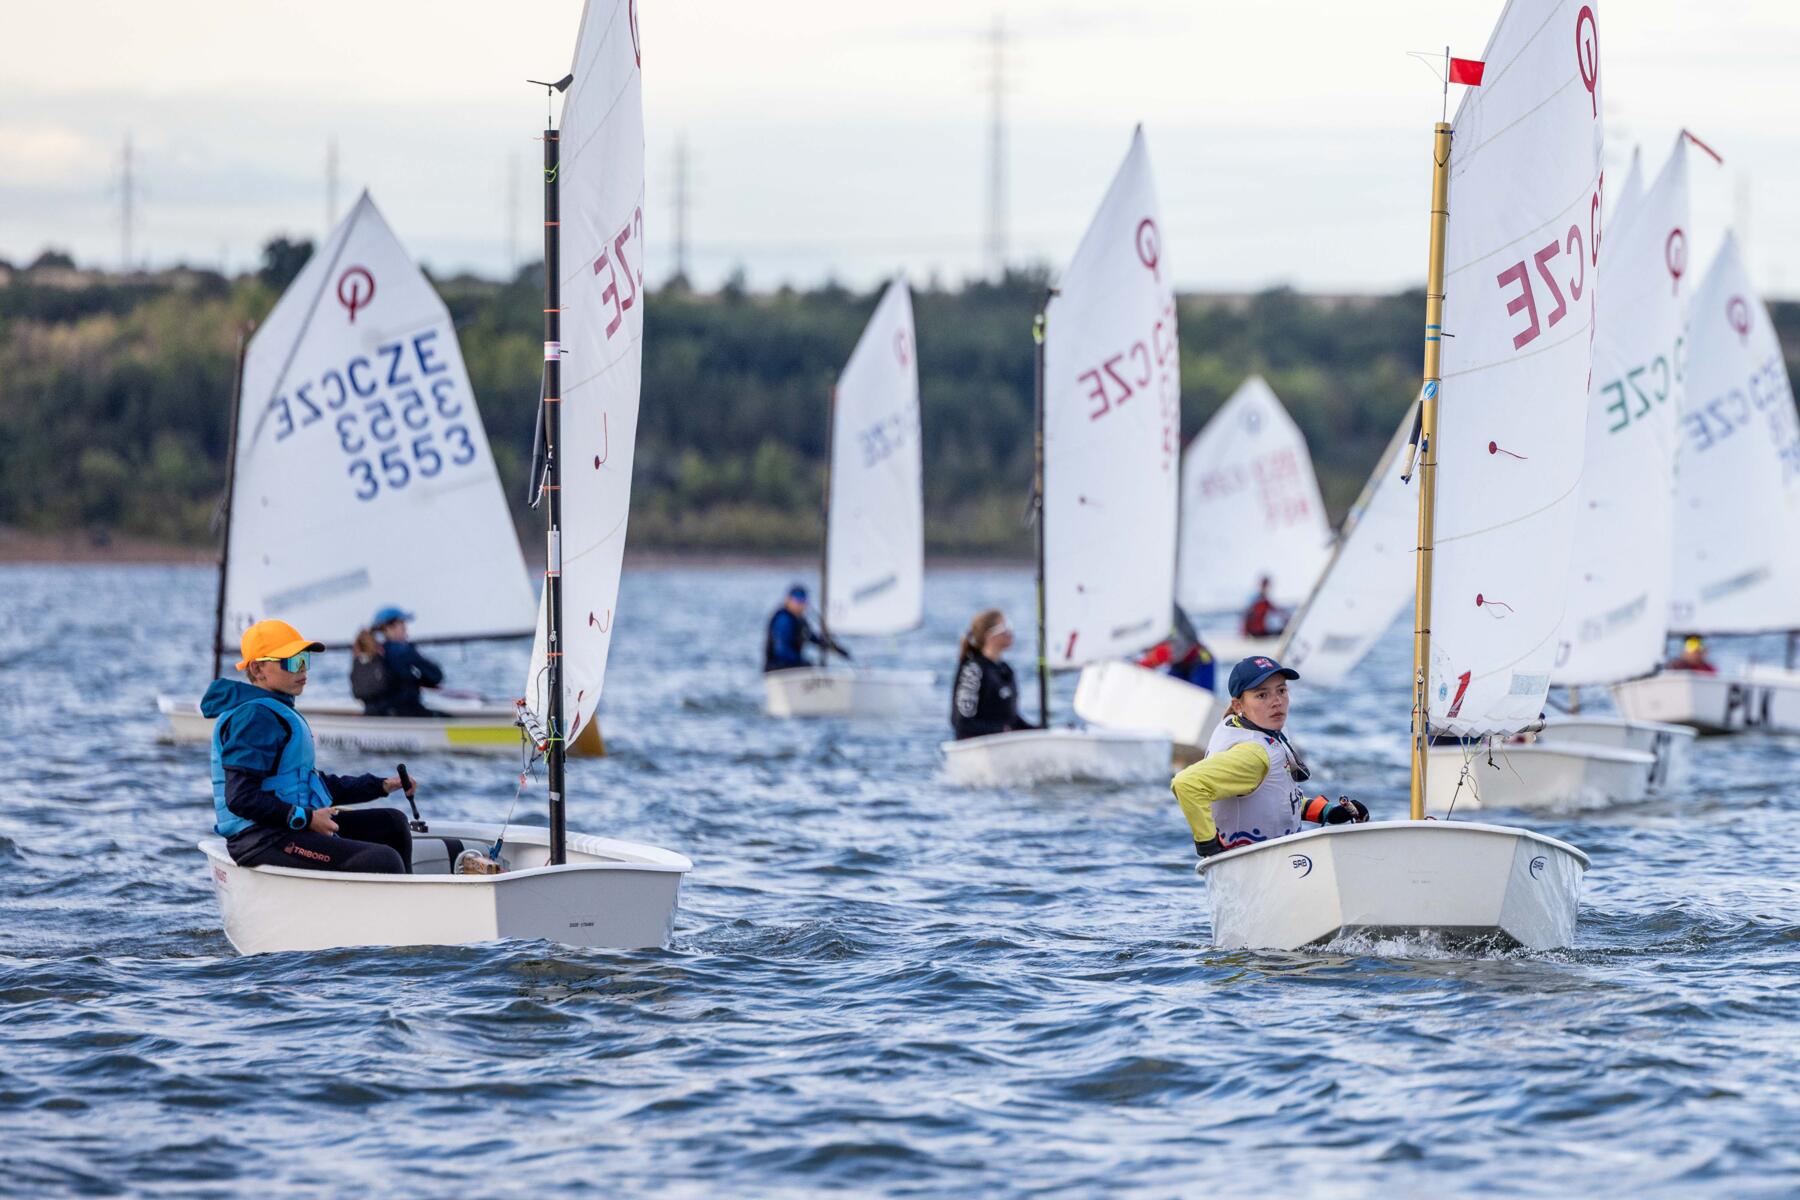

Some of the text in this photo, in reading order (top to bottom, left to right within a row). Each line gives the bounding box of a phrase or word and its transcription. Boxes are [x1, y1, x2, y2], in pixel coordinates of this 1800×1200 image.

[348, 330, 448, 398] CZE
[349, 424, 476, 501] 3553
[294, 846, 331, 862] TRIBORD
